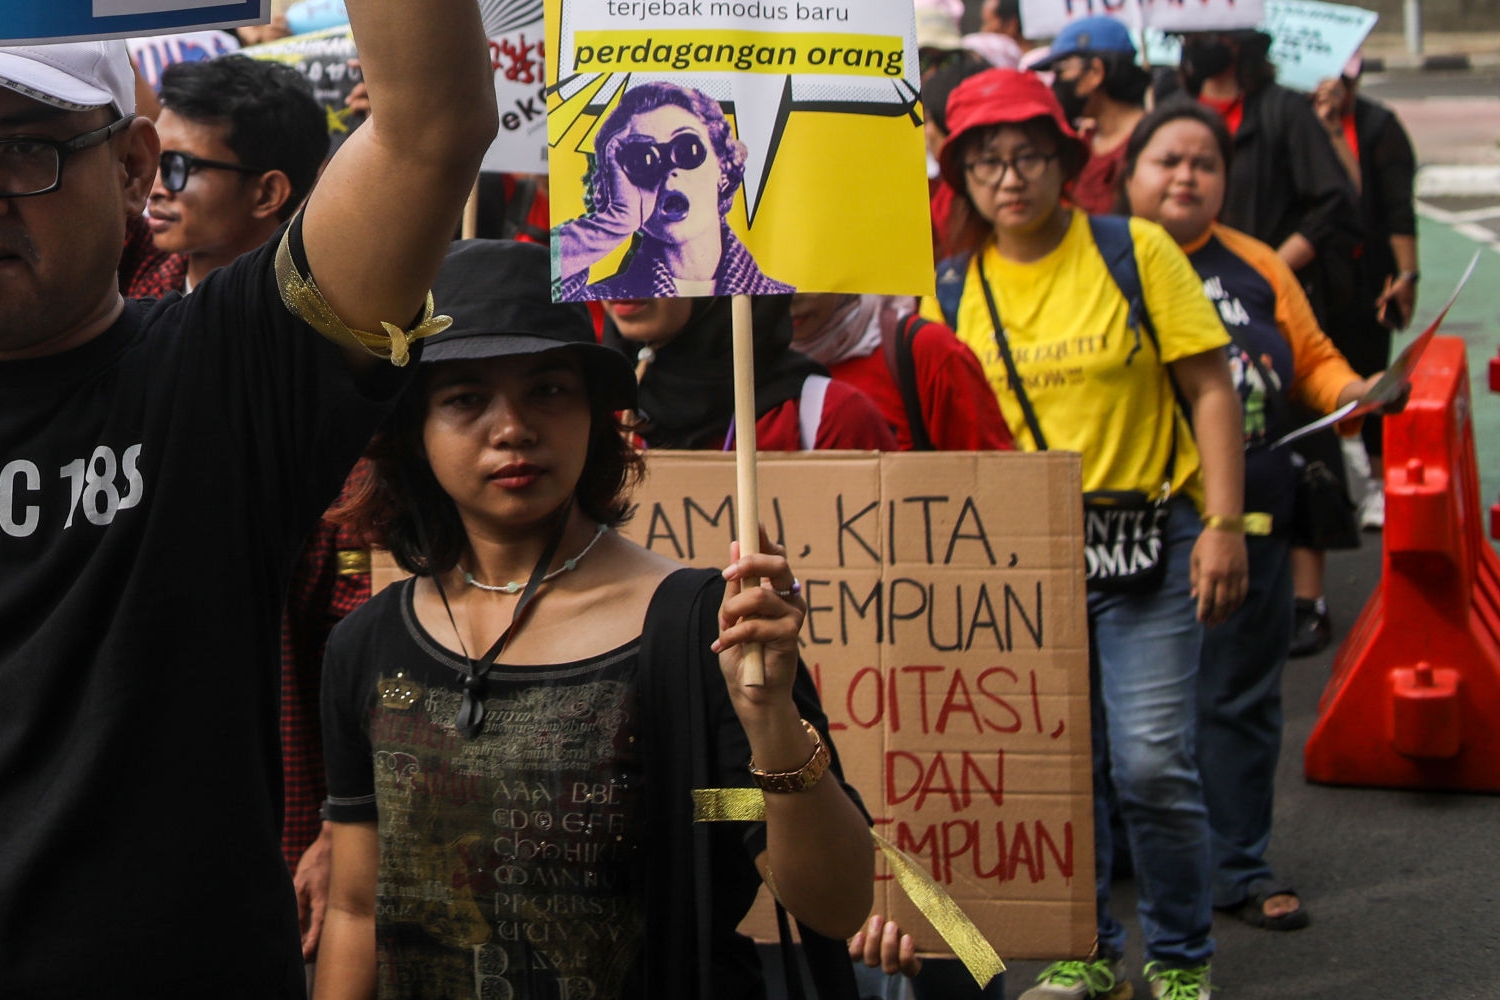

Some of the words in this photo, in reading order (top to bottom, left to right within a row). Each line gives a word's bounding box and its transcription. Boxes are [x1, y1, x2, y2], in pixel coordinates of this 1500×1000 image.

[710, 1, 788, 20] modus
[796, 2, 849, 21] baru
[573, 37, 797, 71] perdagangan
[806, 46, 904, 75] orang
[837, 494, 1019, 568] KITA,
[885, 749, 1005, 812] DAN
